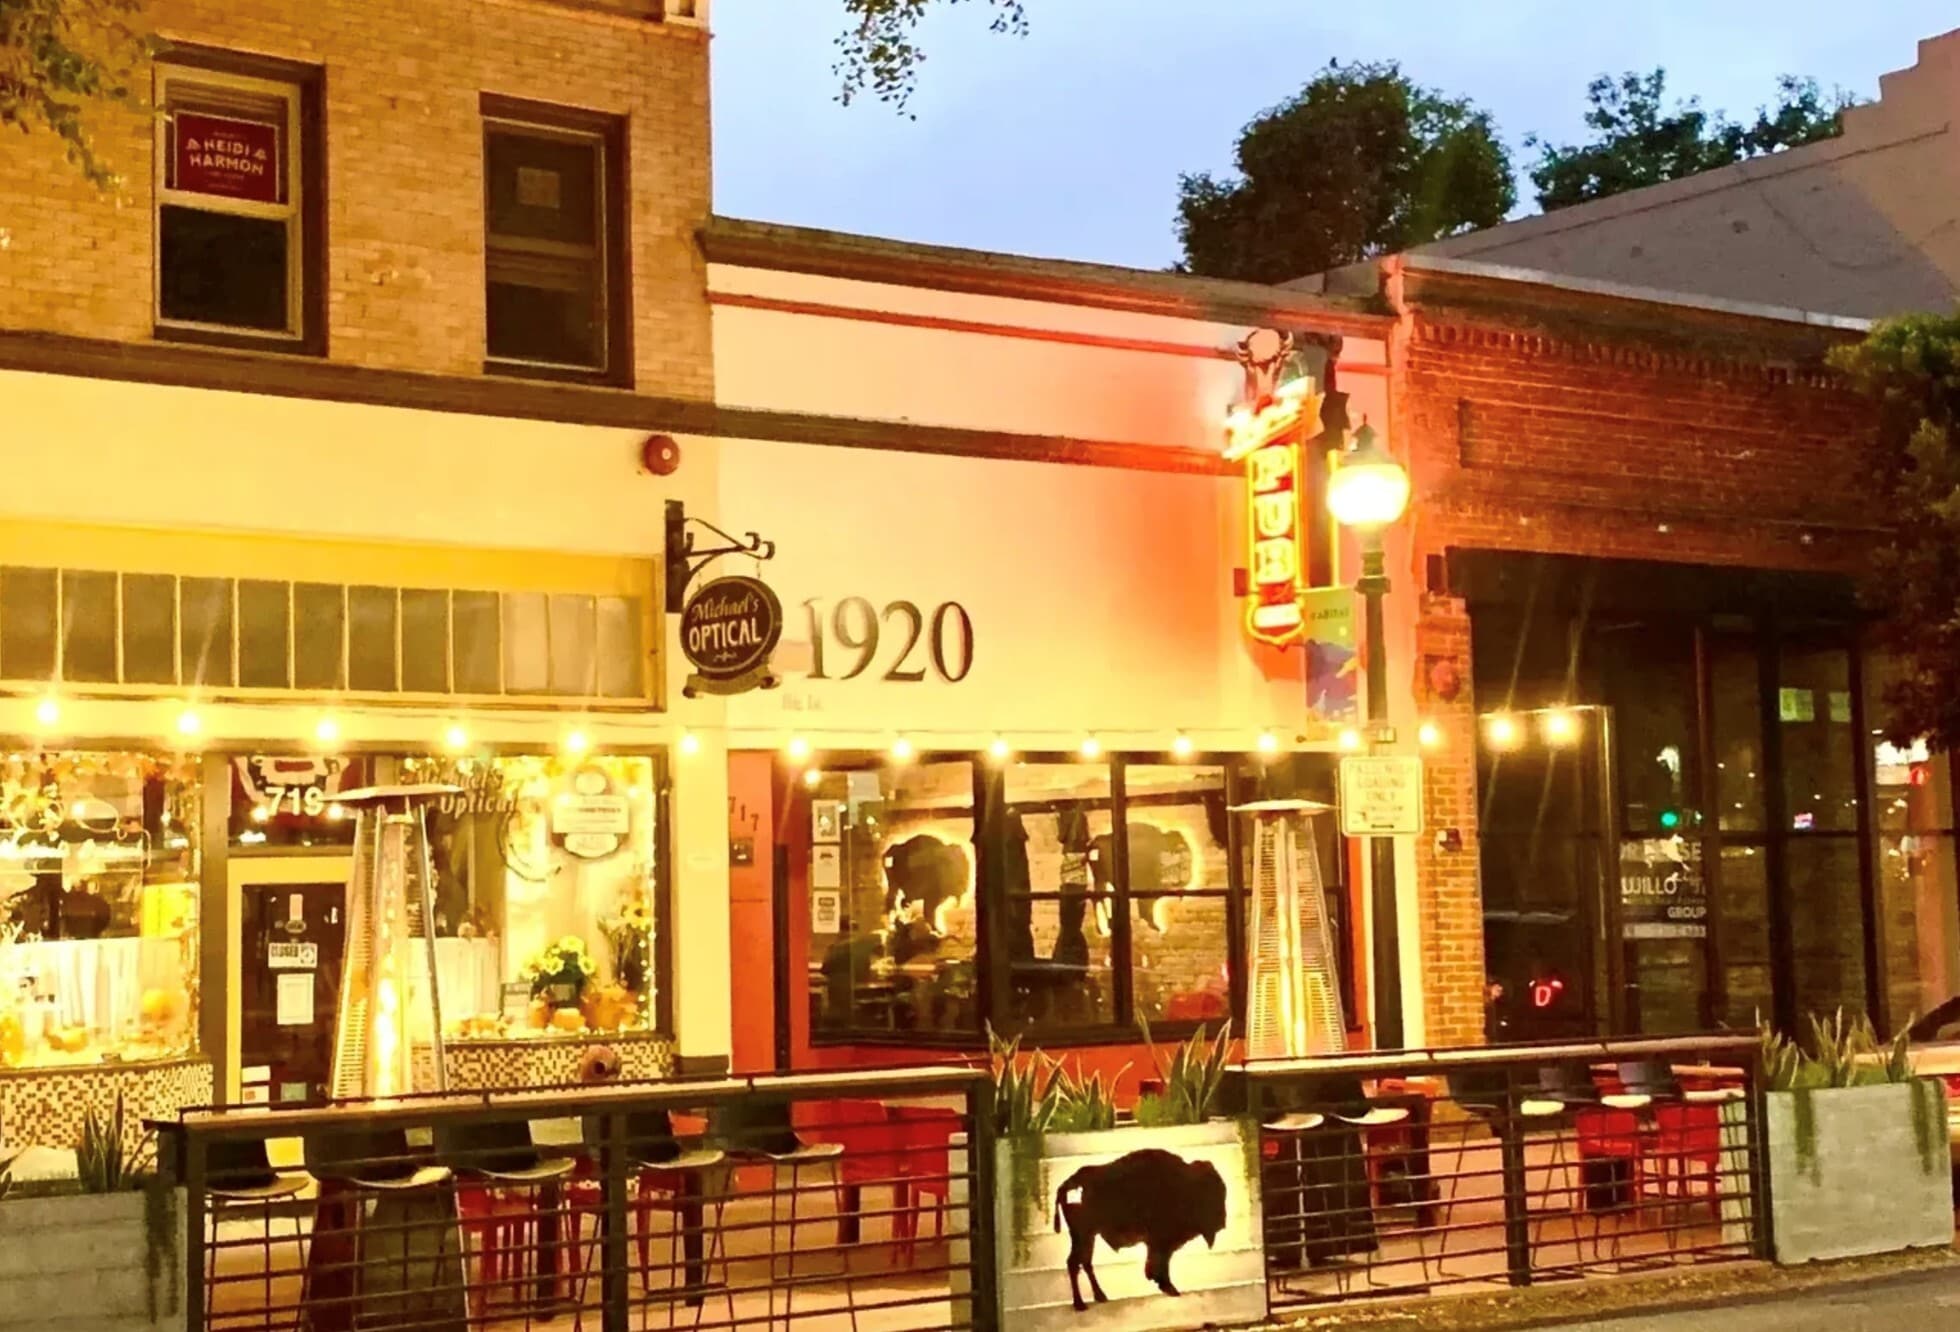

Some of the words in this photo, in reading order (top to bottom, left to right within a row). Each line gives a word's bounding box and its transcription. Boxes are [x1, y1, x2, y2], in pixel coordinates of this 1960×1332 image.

[204, 139, 250, 156] HEIDI
[189, 153, 264, 175] HARMON
[690, 592, 760, 622] Michael's
[688, 617, 762, 653] OPTICAL
[801, 595, 974, 683] 1920
[264, 787, 325, 817] 719
[1667, 905, 1707, 919] GROUP
